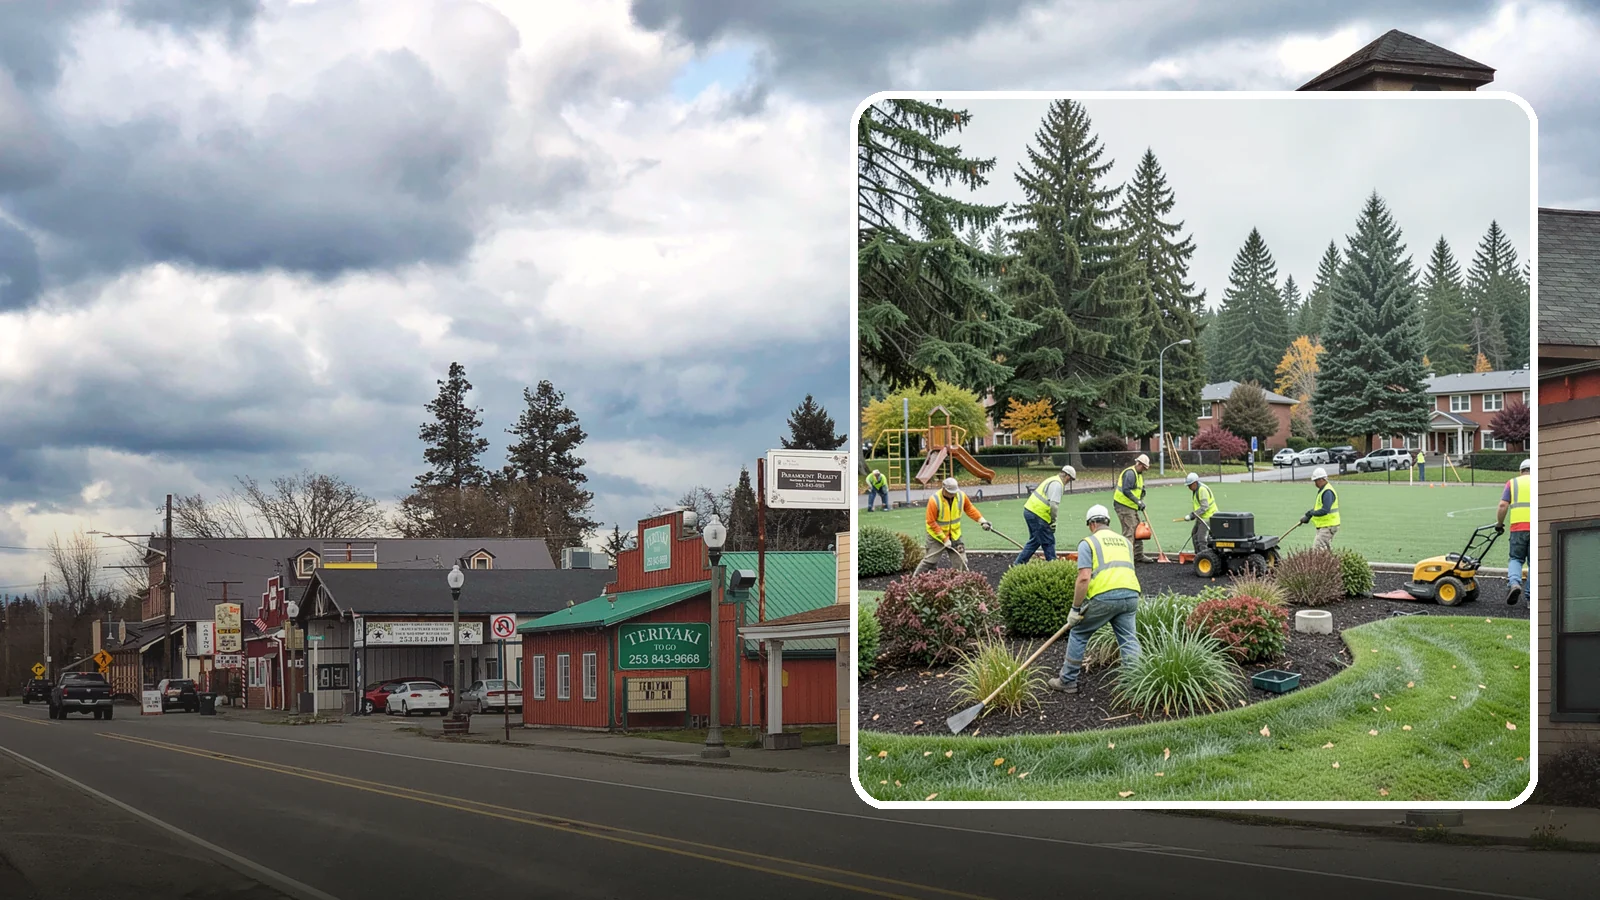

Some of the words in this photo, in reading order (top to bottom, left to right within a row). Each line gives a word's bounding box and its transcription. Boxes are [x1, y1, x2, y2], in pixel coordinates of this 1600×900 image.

[625, 627, 702, 646] TERIYAKI
[629, 654, 648, 664] 253
[652, 653, 700, 664] 843-9668
